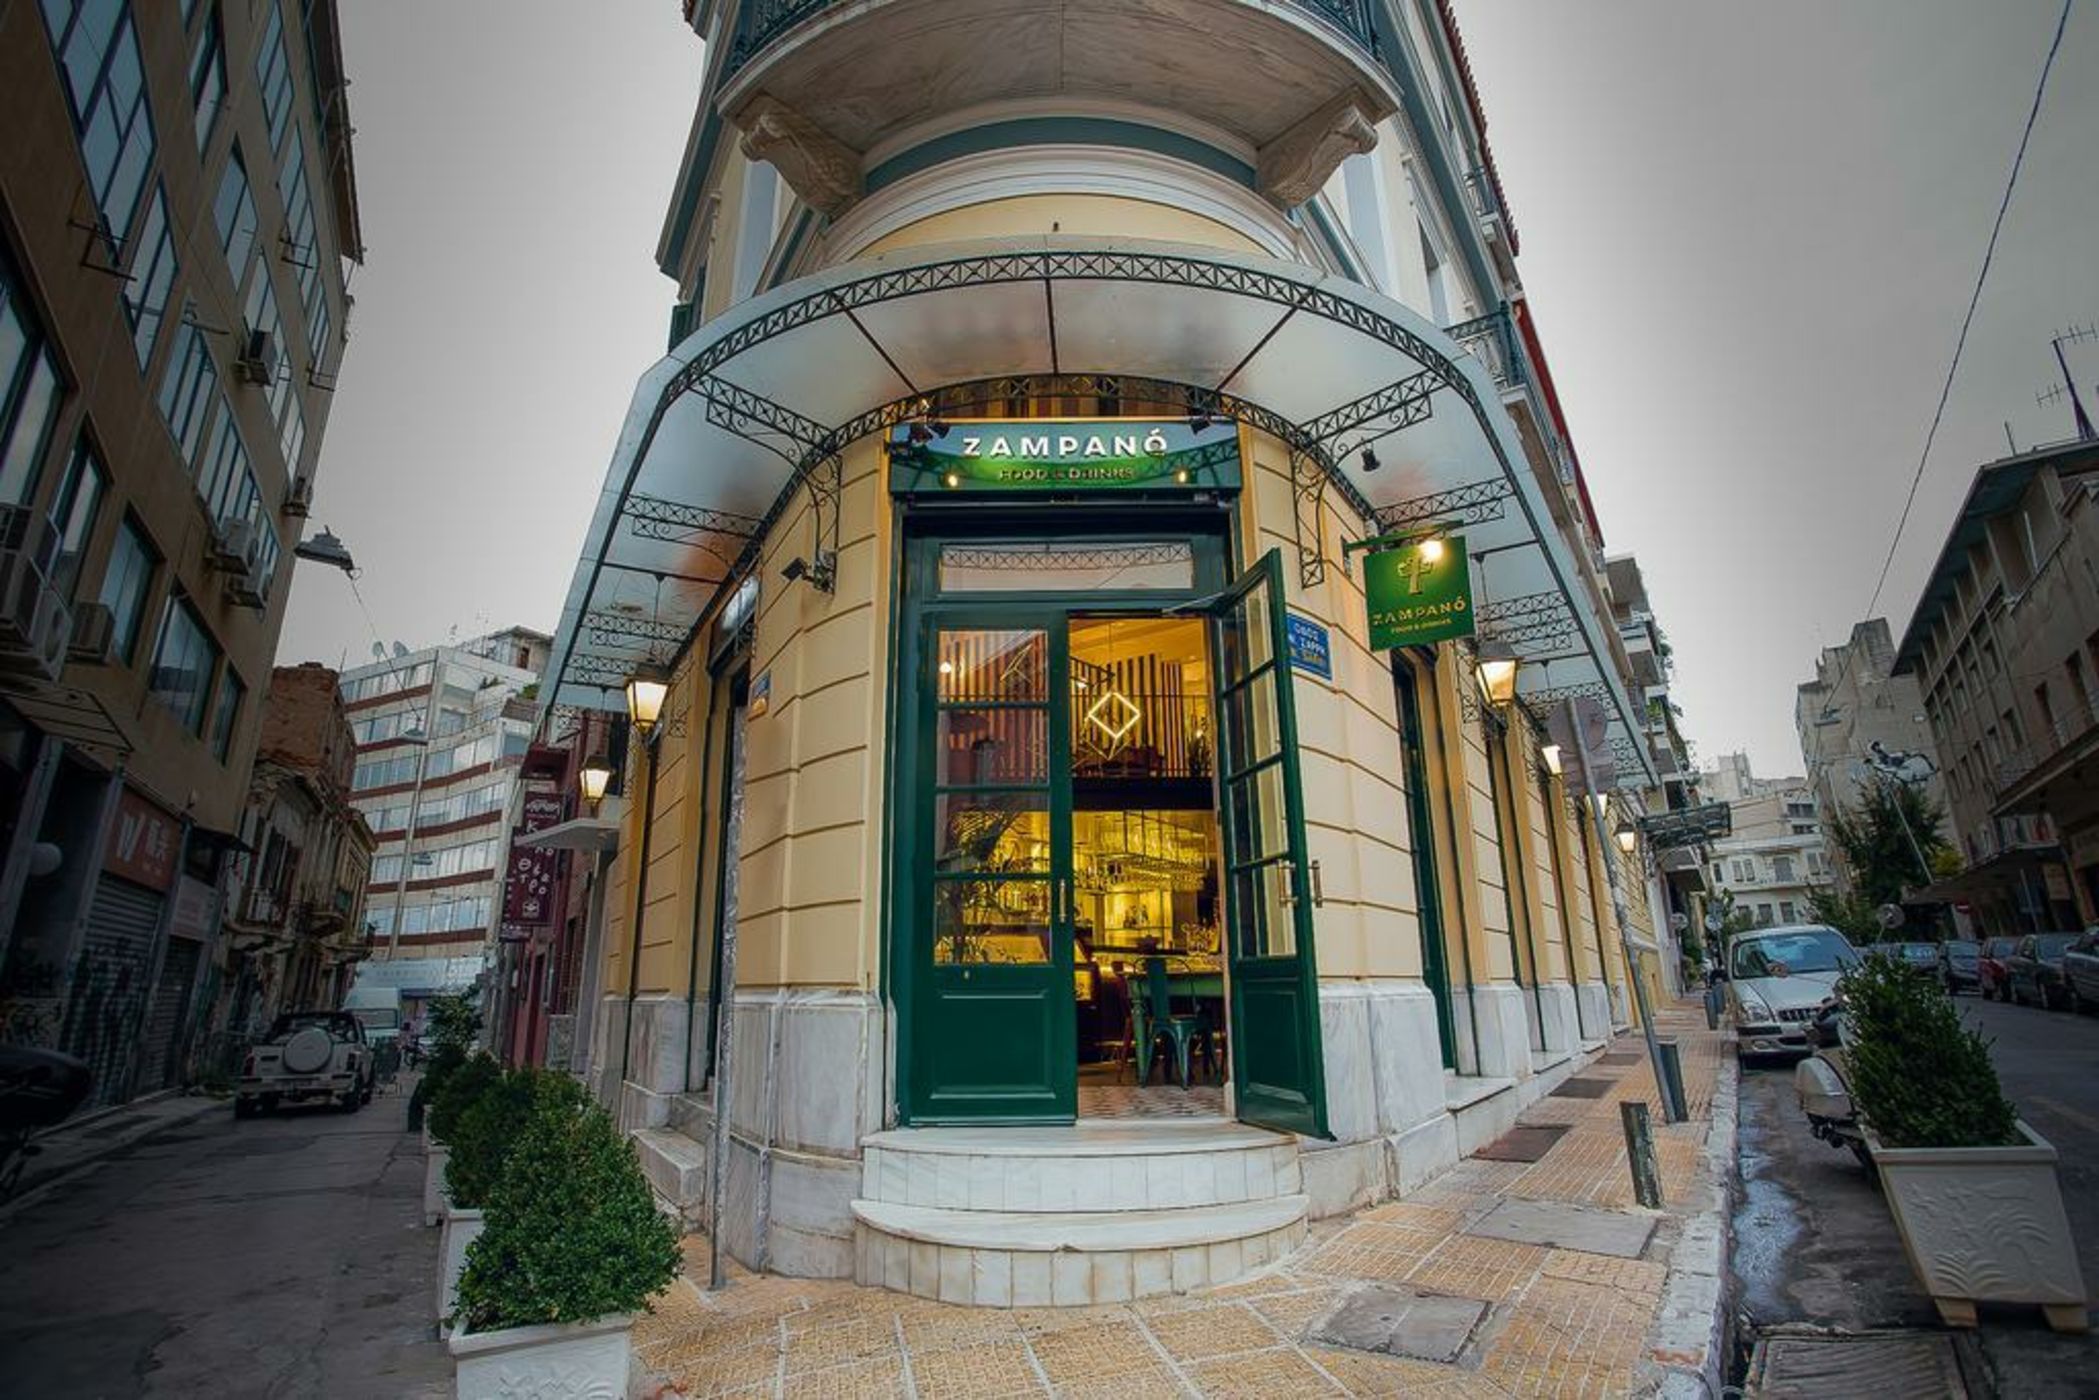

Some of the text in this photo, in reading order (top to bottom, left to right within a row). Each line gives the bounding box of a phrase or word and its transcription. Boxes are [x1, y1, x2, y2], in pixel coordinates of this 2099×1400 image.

[962, 428, 1168, 458] ZAMPANÓ
[1000, 466, 1048, 481] FOOD
[1068, 466, 1134, 480] DRINKS
[1373, 596, 1466, 626] ZAMPANÓ
